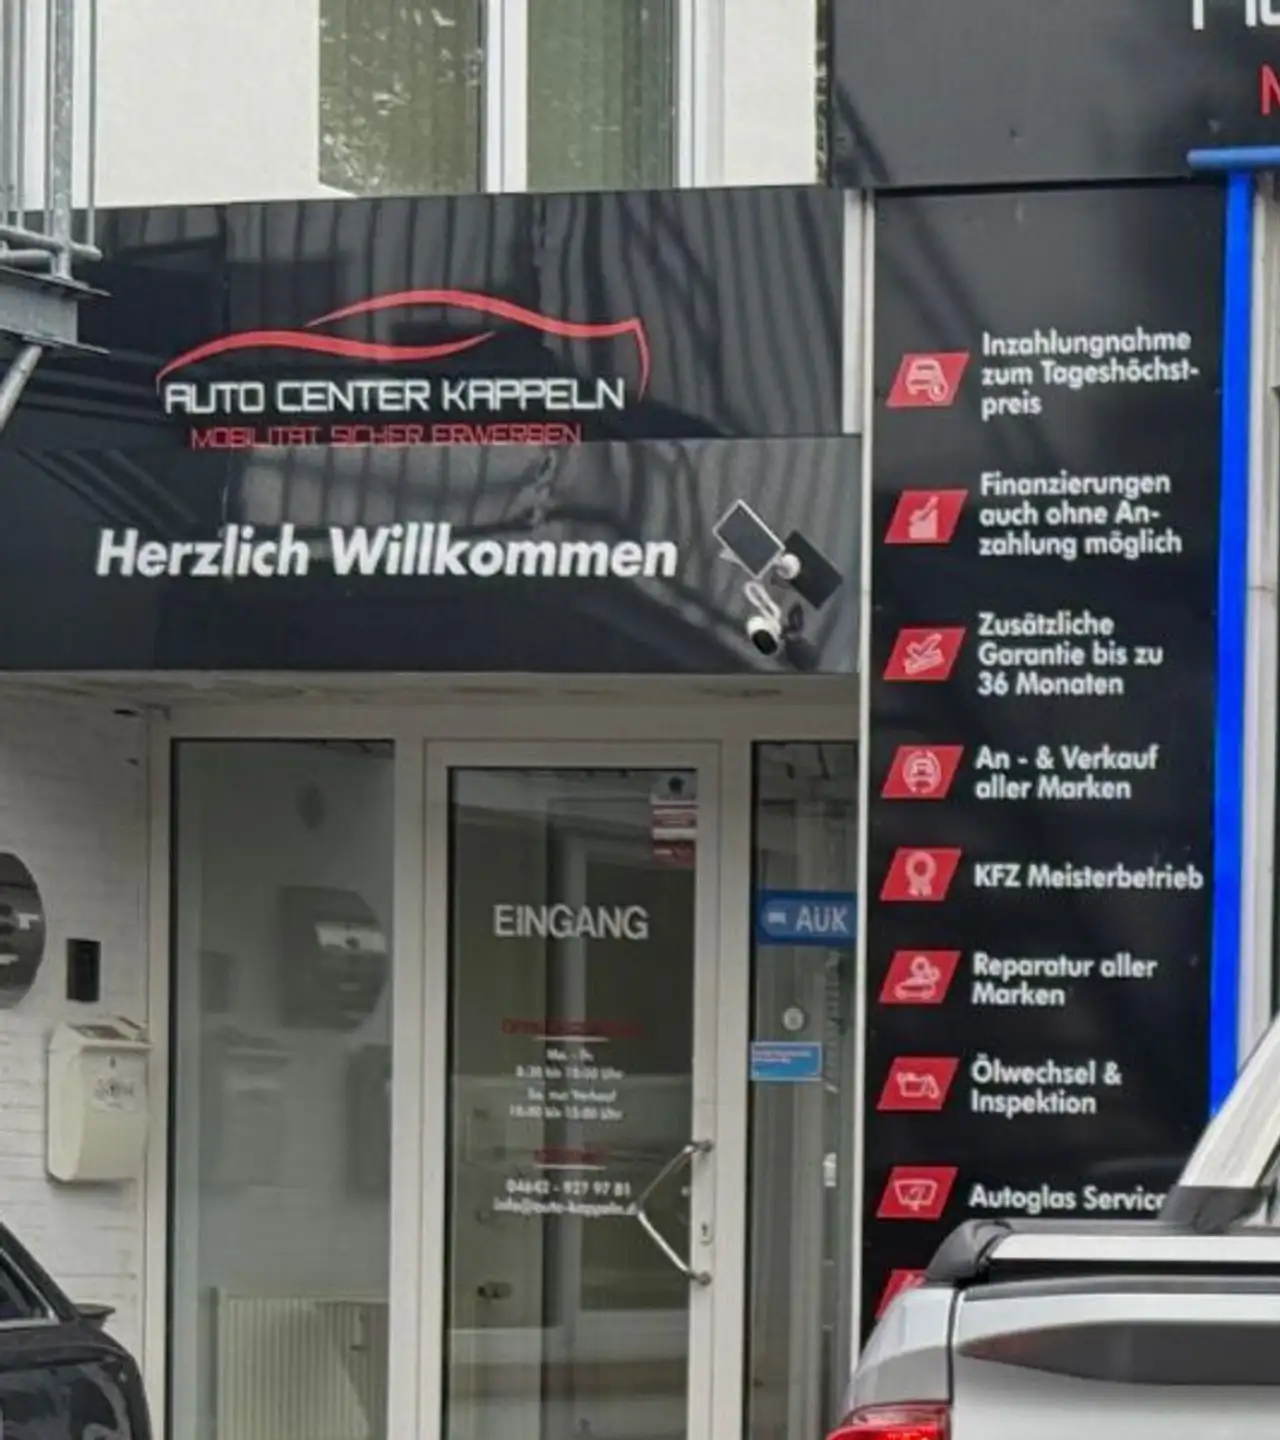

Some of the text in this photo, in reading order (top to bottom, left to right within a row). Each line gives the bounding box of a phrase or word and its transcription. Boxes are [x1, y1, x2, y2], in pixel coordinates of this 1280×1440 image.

[982, 326, 1192, 358] Inzahlungnahme
[981, 355, 1200, 390] zum Tageshöchst-
[164, 377, 624, 413] AUTO CENTER KAPPELN
[981, 389, 1042, 422] preis
[331, 423, 422, 447] SICHER
[433, 422, 581, 447] ERWERBEN
[980, 469, 1171, 499] Finanzierungen
[979, 499, 1160, 526] auch ohne An-
[96, 522, 678, 578] Herzlich Willkommen
[979, 528, 1183, 561] zahlung möglich
[978, 610, 1115, 637] Zusätzliche
[978, 640, 1164, 666] Garantie bis zu
[978, 671, 1124, 696] 36 Monaten
[975, 745, 1010, 769] An
[1035, 745, 1055, 770] &
[1061, 743, 1160, 770] Verkauf
[975, 774, 1133, 799] aller Marken
[974, 862, 1204, 889] KFZ Meisterbetrieb
[493, 903, 649, 940] EINGANG
[972, 951, 1158, 982] Reparatur aller
[971, 981, 1066, 1006] Marken
[971, 1053, 1122, 1086] Ölwechsel &
[971, 1088, 1097, 1119] Inspektion
[969, 1183, 1076, 1214] Autoglas
